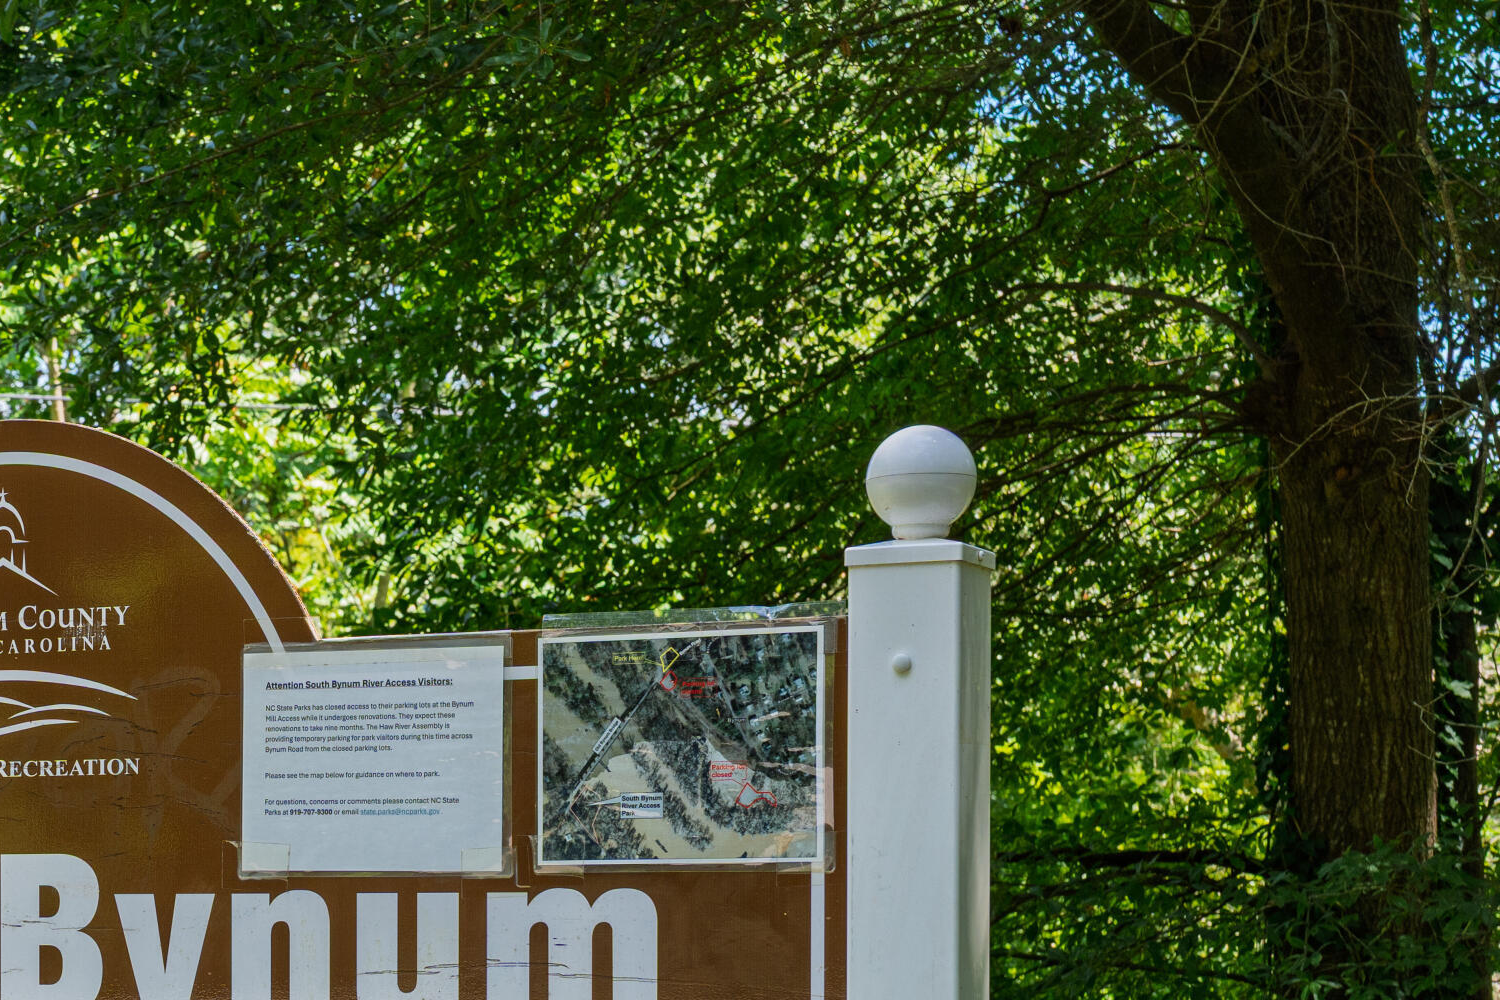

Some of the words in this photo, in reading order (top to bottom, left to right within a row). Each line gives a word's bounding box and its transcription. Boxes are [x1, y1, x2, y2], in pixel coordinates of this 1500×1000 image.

[19, 605, 130, 630] COUNTY
[265, 681, 304, 690] Attention
[305, 681, 330, 689] South
[332, 680, 361, 689] Bynum
[362, 679, 384, 688] River
[385, 679, 416, 687] Access
[418, 678, 453, 686] Visitors:
[265, 704, 276, 712] NC
[378, 702, 393, 710] their
[394, 702, 418, 710] parking
[451, 701, 474, 709] Bynum
[414, 712, 436, 720] expect
[412, 722, 443, 730] Assembly
[400, 733, 421, 742] during
[265, 746, 287, 754] Bynum
[354, 745, 378, 753] parking
[310, 772, 325, 780] map
[355, 771, 384, 779] guidance
[382, 797, 404, 805] please
